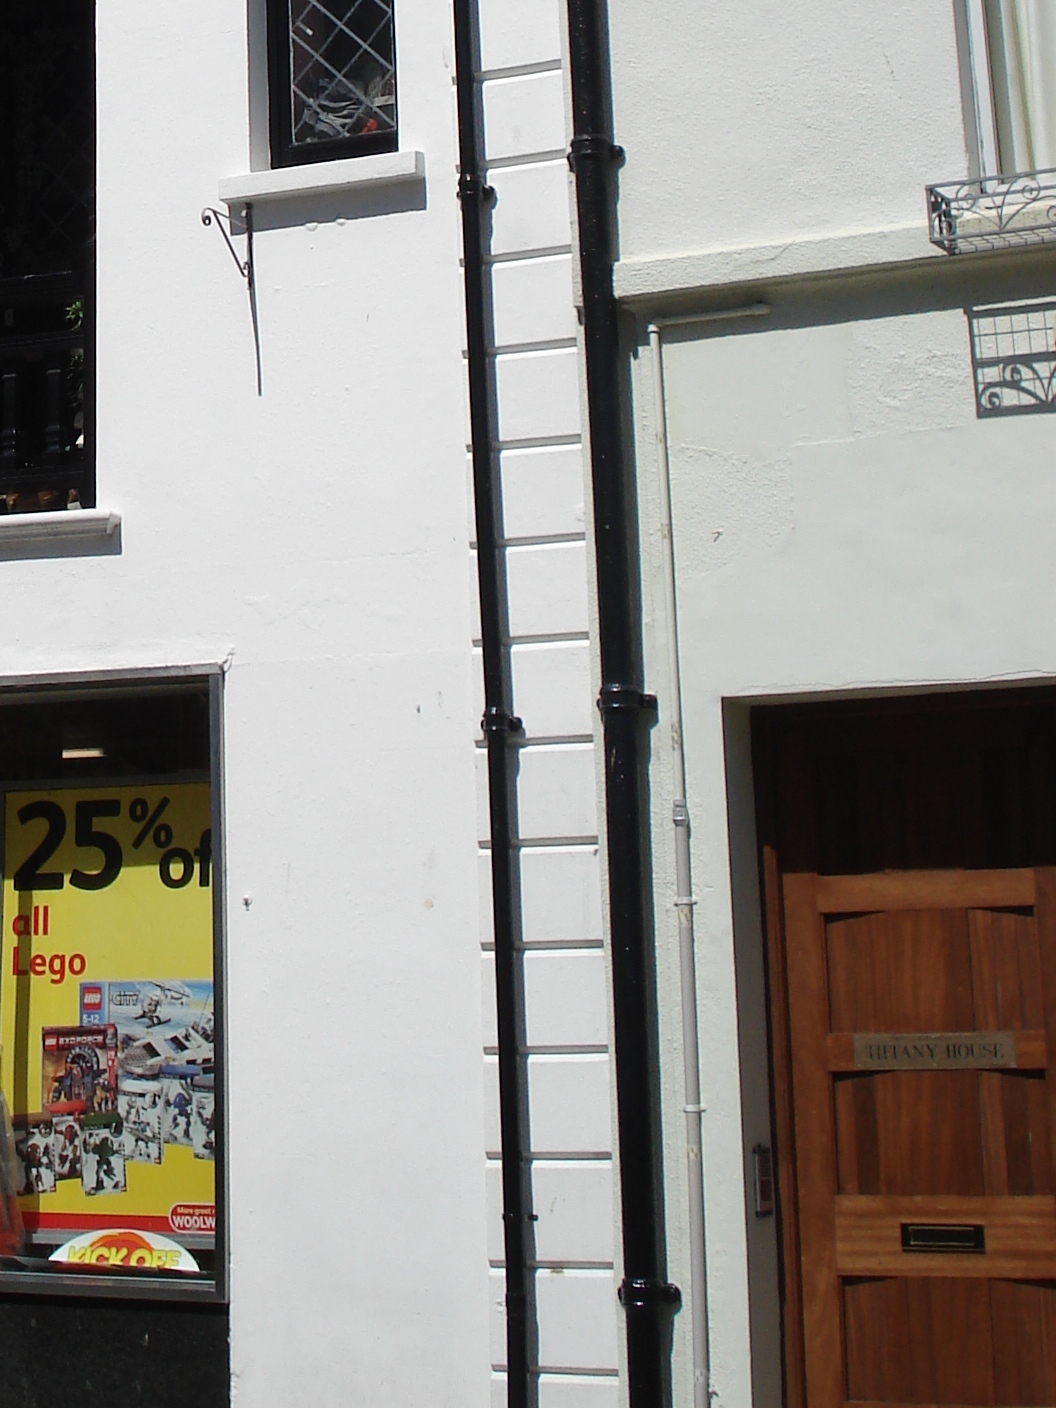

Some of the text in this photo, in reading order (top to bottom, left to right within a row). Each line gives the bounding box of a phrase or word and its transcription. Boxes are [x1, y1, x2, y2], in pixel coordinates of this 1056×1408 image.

[14, 797, 212, 890] 25% of
[12, 905, 49, 936] all
[12, 946, 86, 985] Lego
[112, 992, 140, 1006] CITY
[946, 1043, 1004, 1060] HOUSE
[172, 1215, 216, 1229] WOOLW
